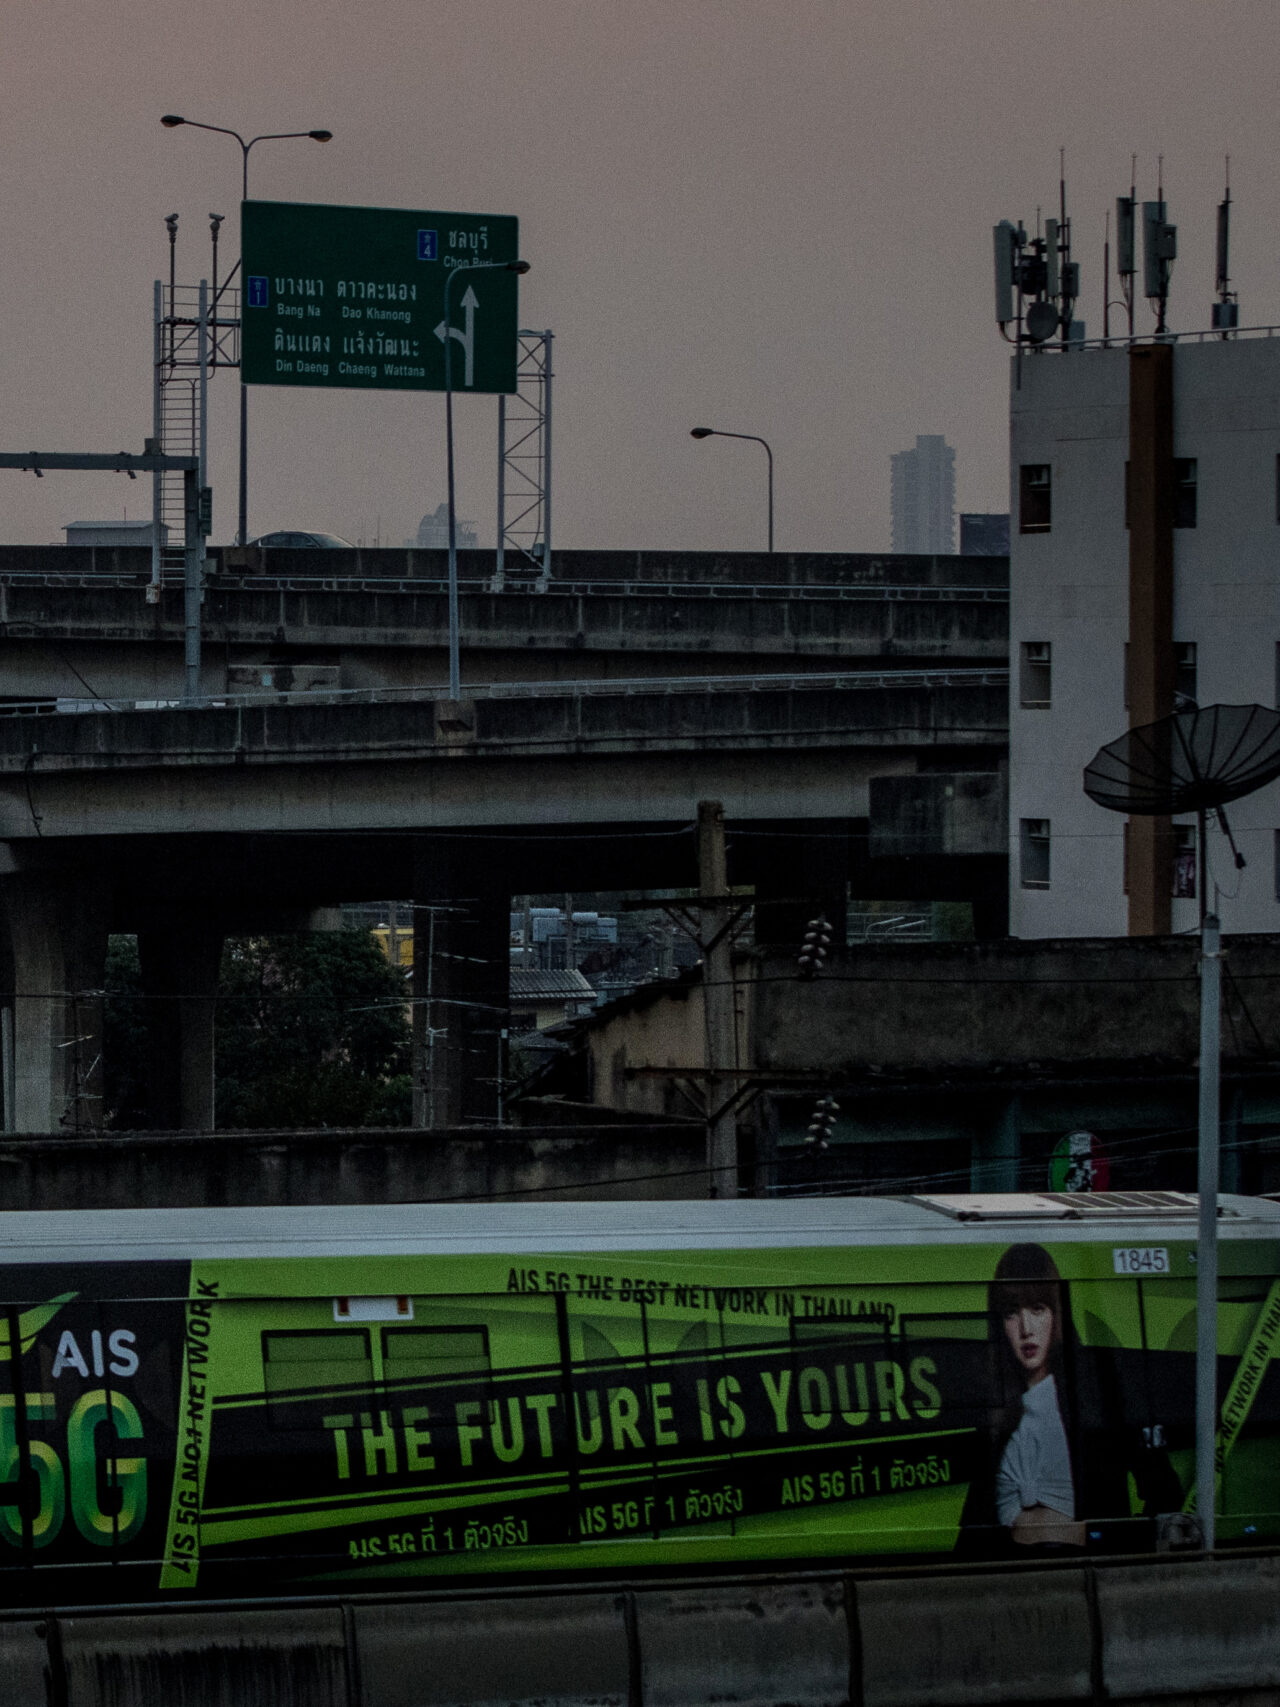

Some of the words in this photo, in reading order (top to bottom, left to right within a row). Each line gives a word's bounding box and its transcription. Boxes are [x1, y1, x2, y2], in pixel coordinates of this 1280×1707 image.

[448, 226, 488, 255] ชลบุรี
[275, 277, 324, 297] บางนา
[337, 280, 417, 301] ดาวคะนอง
[277, 303, 304, 319] Bang
[307, 304, 321, 317] Na
[342, 306, 362, 319] Dao
[366, 307, 412, 324] Khanong
[274, 328, 331, 353] ดินแดง
[343, 330, 420, 357] แจ้งวัฒนะ
[276, 359, 292, 373] Din
[296, 360, 329, 376] Daeng
[338, 361, 377, 378] Chaeng
[384, 363, 426, 378] Wattana
[1117, 1250, 1166, 1272] 1845
[507, 1268, 540, 1292] AIS
[545, 1271, 570, 1291] 5G
[577, 1274, 614, 1301] THE
[620, 1278, 670, 1306] BEST
[674, 1283, 769, 1316] NETWORK
[775, 1293, 795, 1318] IN
[51, 1329, 140, 1378] AIS
[187, 1279, 219, 1421] NETWORK
[1222, 1360, 1260, 1440] NETWORK
[1253, 1340, 1270, 1361] IN
[322, 1405, 437, 1480] THE
[455, 1382, 680, 1467] FUTURE
[696, 1375, 747, 1442] IS
[760, 1355, 943, 1434] YOURS
[182, 1428, 202, 1482] NO.1
[781, 1474, 815, 1506] AIS
[819, 1470, 846, 1500] 5G
[850, 1455, 865, 1495] ที่
[872, 1465, 881, 1492] 1
[889, 1455, 951, 1490] ตัวจริง
[176, 1490, 200, 1525] 5G
[611, 1500, 639, 1531] 5G
[665, 1495, 676, 1523] 1
[387, 1531, 416, 1555] 5G
[421, 1516, 437, 1552] ที่
[443, 1526, 455, 1551] 1
[464, 1515, 529, 1549] ตัวจริง
